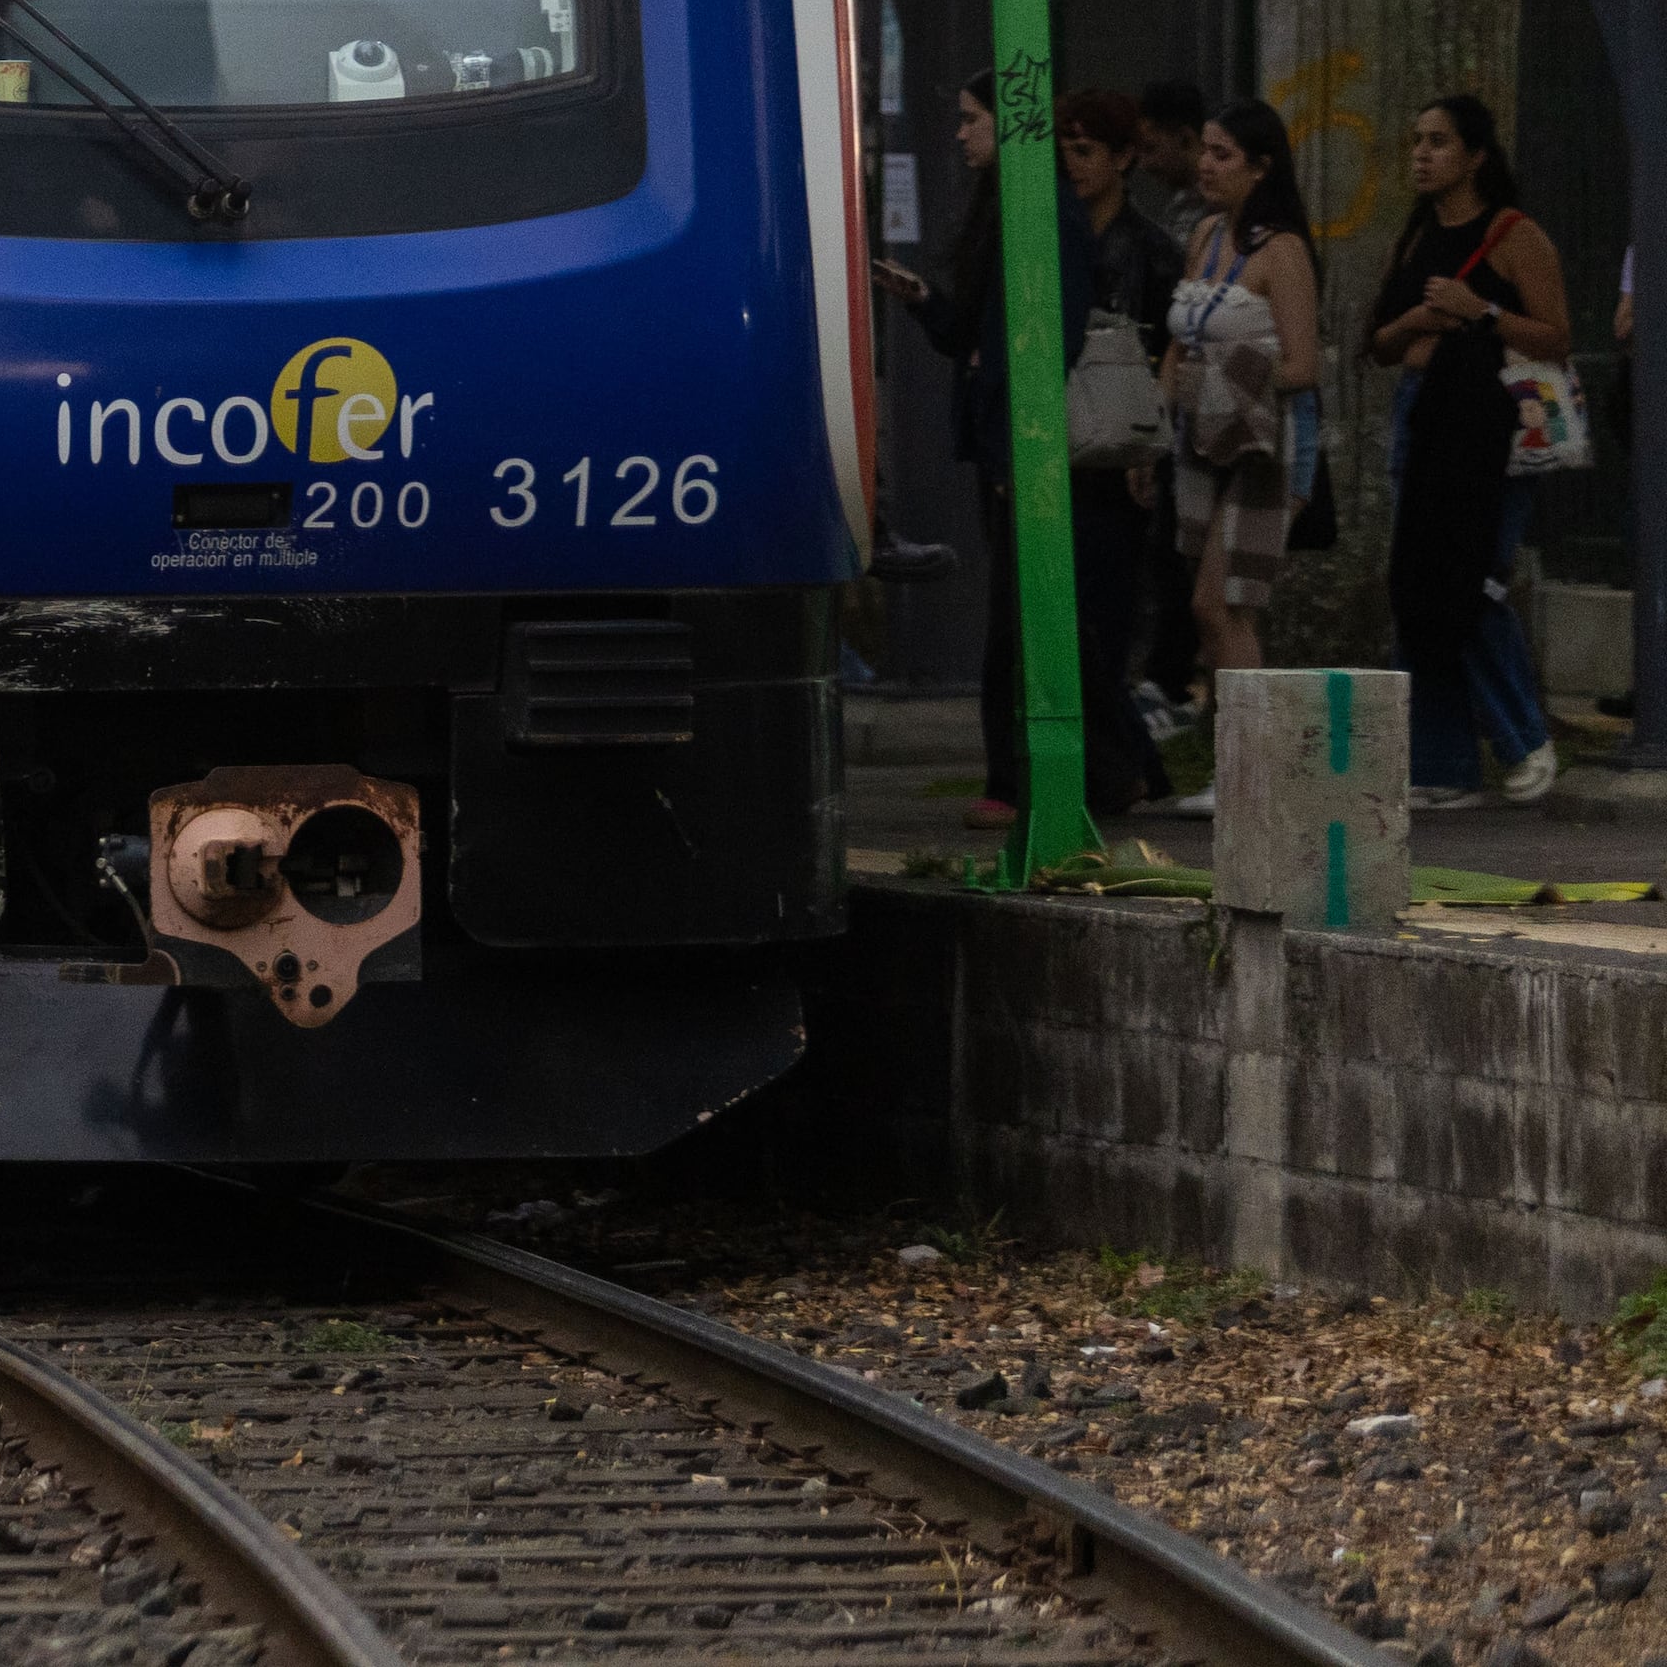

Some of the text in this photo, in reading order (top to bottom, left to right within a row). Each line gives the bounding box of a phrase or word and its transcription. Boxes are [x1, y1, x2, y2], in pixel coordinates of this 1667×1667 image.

[56, 344, 435, 466] incofer
[303, 454, 719, 529] 200 3126
[150, 550, 227, 571] operación
[232, 553, 253, 568] en
[188, 531, 286, 550] Conector de
